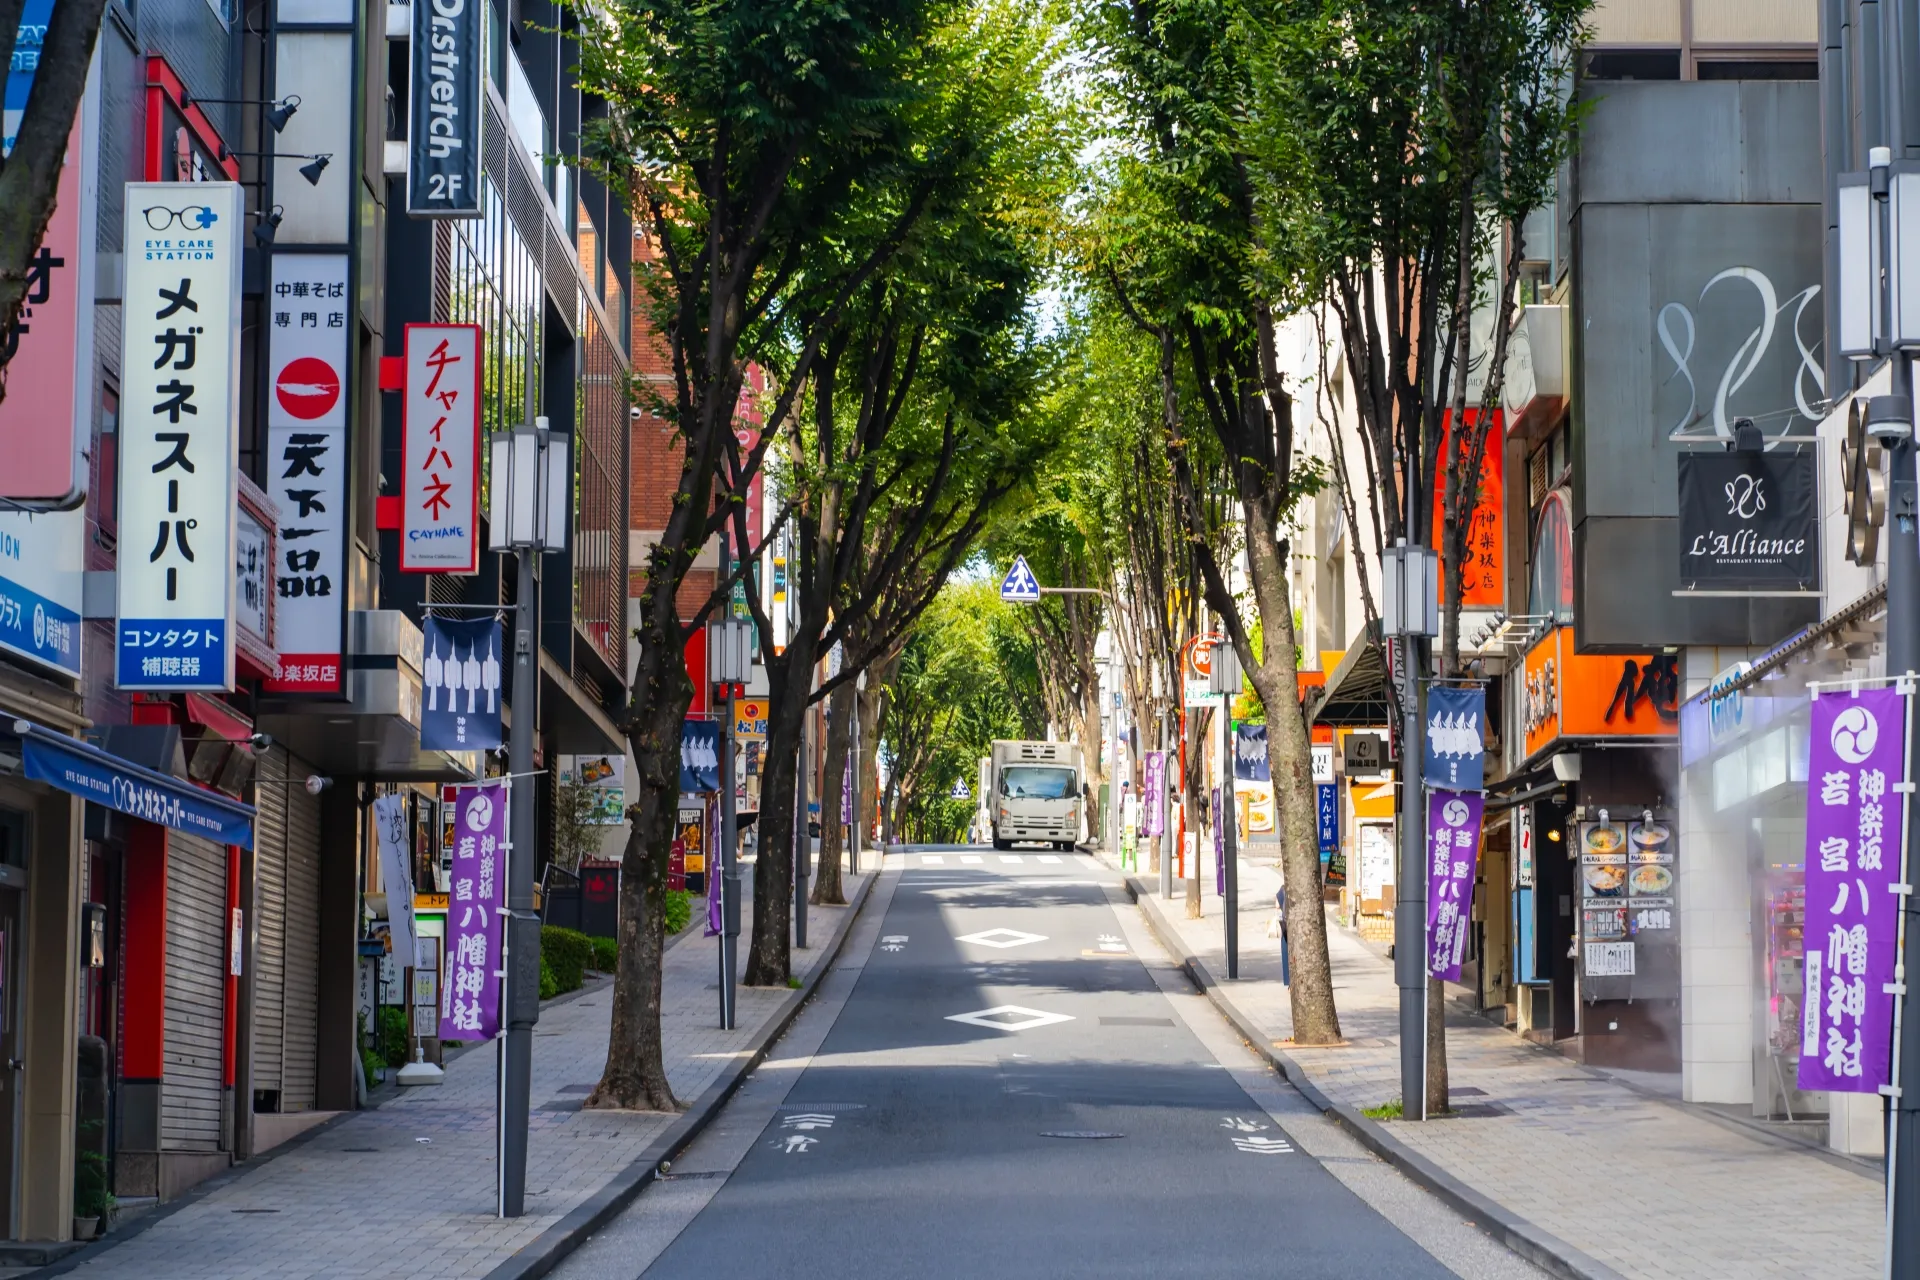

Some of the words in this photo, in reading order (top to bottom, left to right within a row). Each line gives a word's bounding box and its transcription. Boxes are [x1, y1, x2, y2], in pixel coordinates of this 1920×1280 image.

[429, 0, 464, 158] Dr.stretch
[428, 174, 462, 200] 2F
[146, 240, 171, 248] EYE
[179, 239, 213, 248] CARE
[146, 252, 213, 260] STATION
[275, 282, 345, 299] 中華そば
[274, 311, 345, 328] 専門店
[150, 278, 203, 601] メガネスーパー
[422, 338, 461, 521] チャイハネ
[277, 433, 331, 598] 天下一品
[1479, 509, 1497, 589] 神楽坂店
[1689, 529, 1805, 555] L'Alliance
[124, 629, 219, 649] コンタクト
[142, 657, 201, 677] 補聴器
[737, 720, 767, 733] 松屋
[65, 769, 76, 783] EYE
[76, 772, 89, 787] CARE
[90, 778, 110, 794] STATION
[136, 787, 186, 828] メガネスーパー
[187, 812, 195, 824] EYE
[1322, 786, 1332, 840] たんす屋
[1857, 768, 1885, 871] 神楽坂
[478, 834, 496, 900] 神楽坂
[1819, 771, 1870, 1078] 若宮八幡神社
